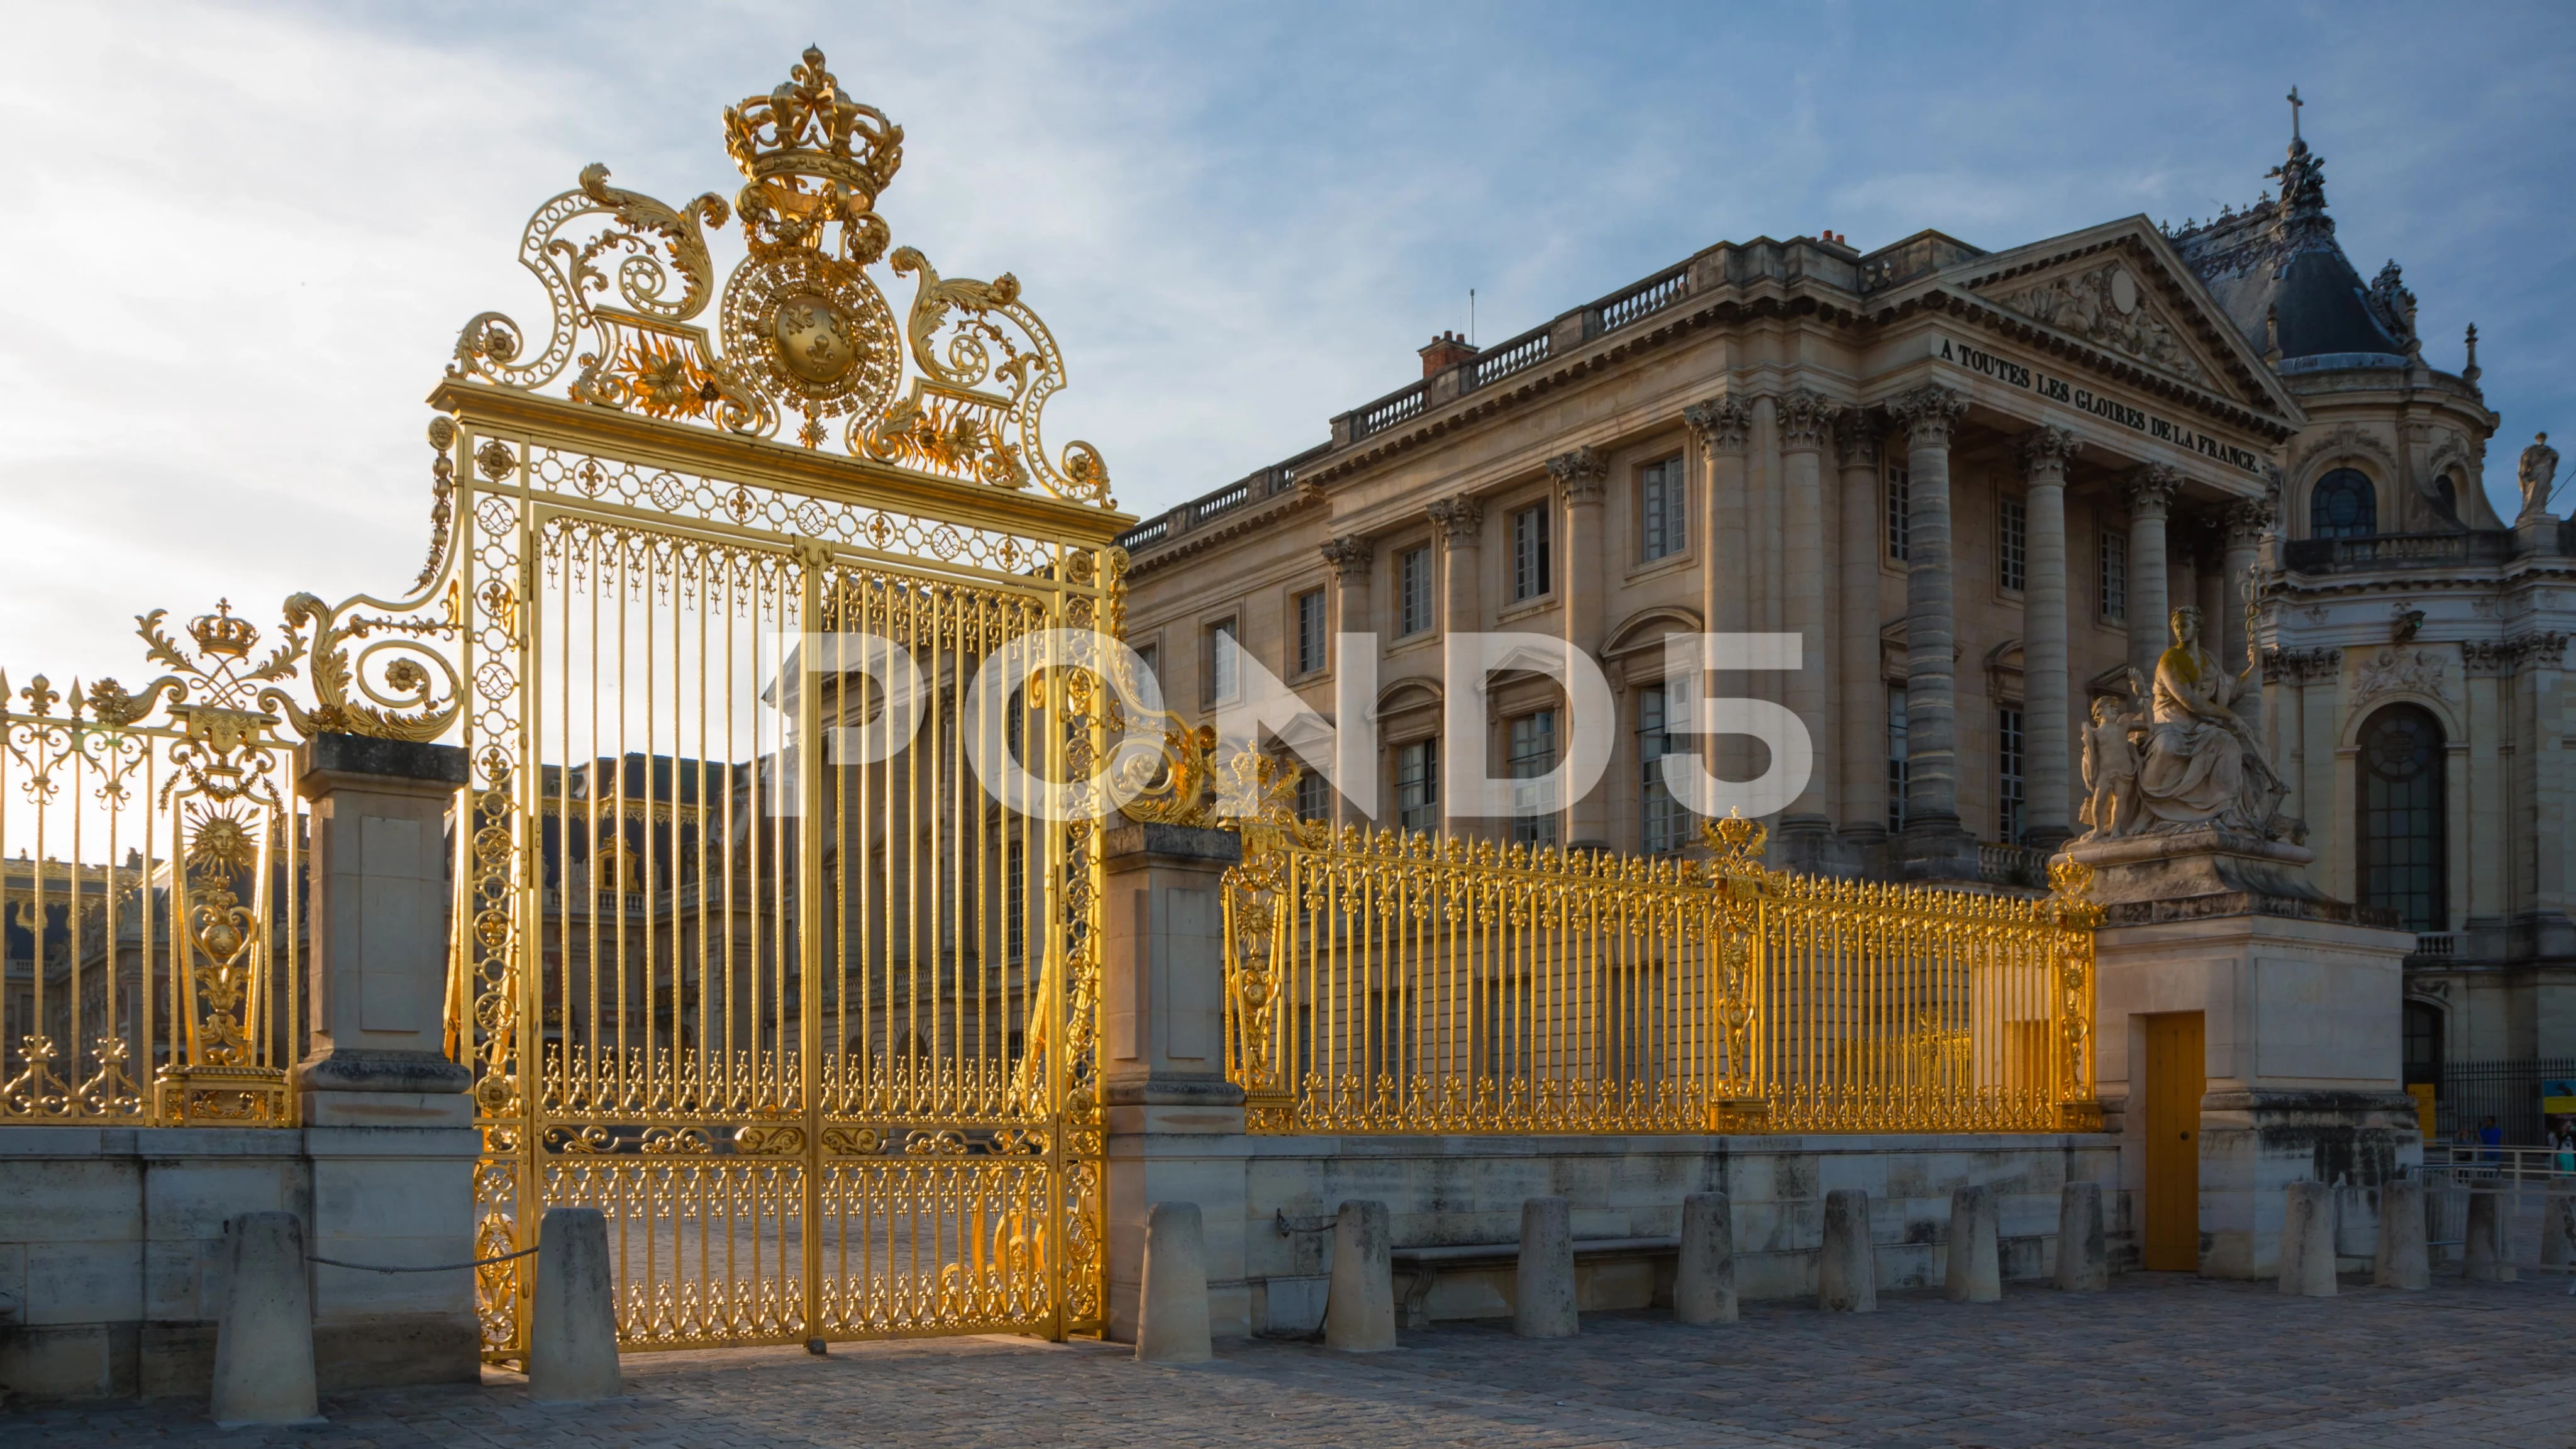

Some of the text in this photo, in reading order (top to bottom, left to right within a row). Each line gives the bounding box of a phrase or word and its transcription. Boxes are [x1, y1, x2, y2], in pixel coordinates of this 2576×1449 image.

[1940, 338, 1953, 361] A
[1958, 344, 2030, 388] TOUTES
[2036, 374, 2070, 403] LES
[2074, 389, 2146, 430] GLOIRES
[2151, 417, 2171, 441] DE
[2174, 426, 2194, 450] LA
